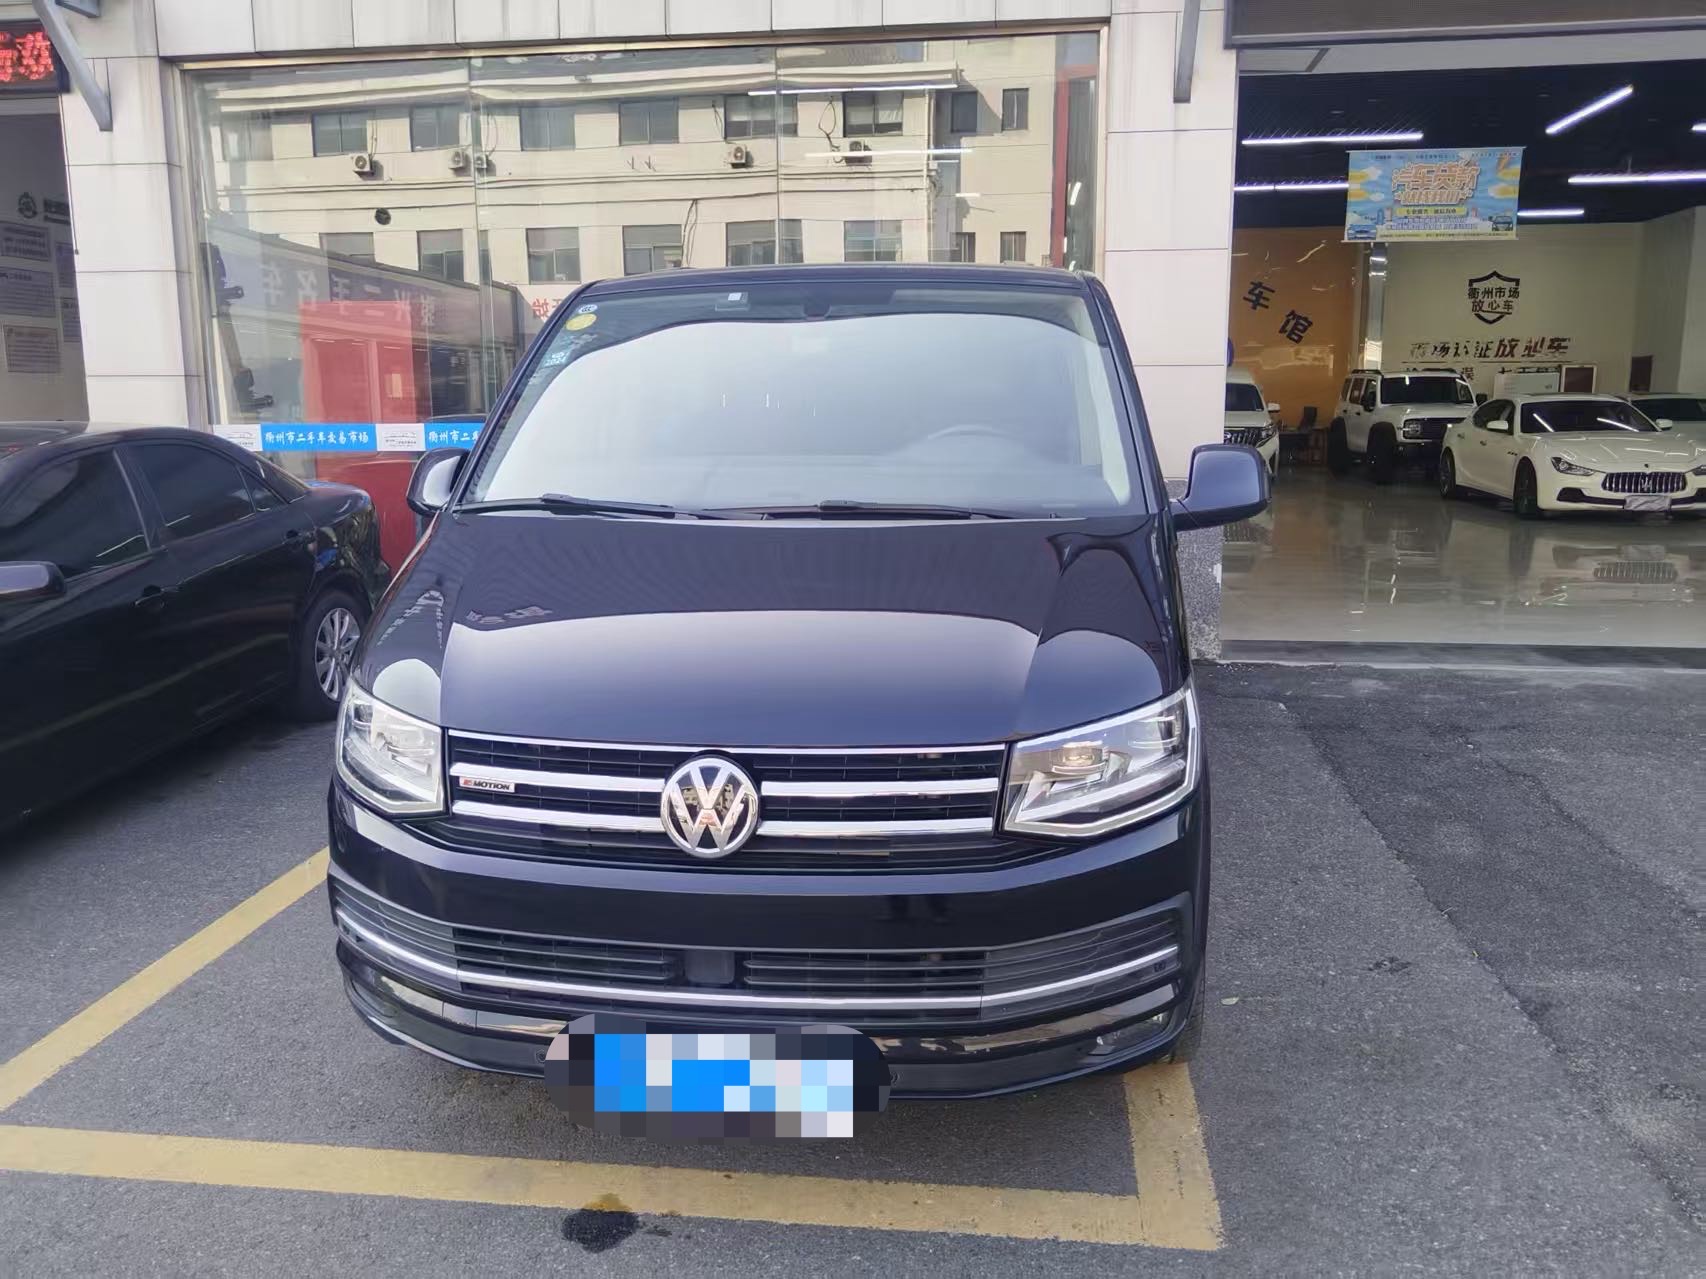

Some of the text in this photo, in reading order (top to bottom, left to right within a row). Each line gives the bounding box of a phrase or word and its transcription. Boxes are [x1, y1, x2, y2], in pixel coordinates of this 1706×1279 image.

[1468, 286, 1520, 300] 衢州市场
[1472, 299, 1514, 312] 放心车
